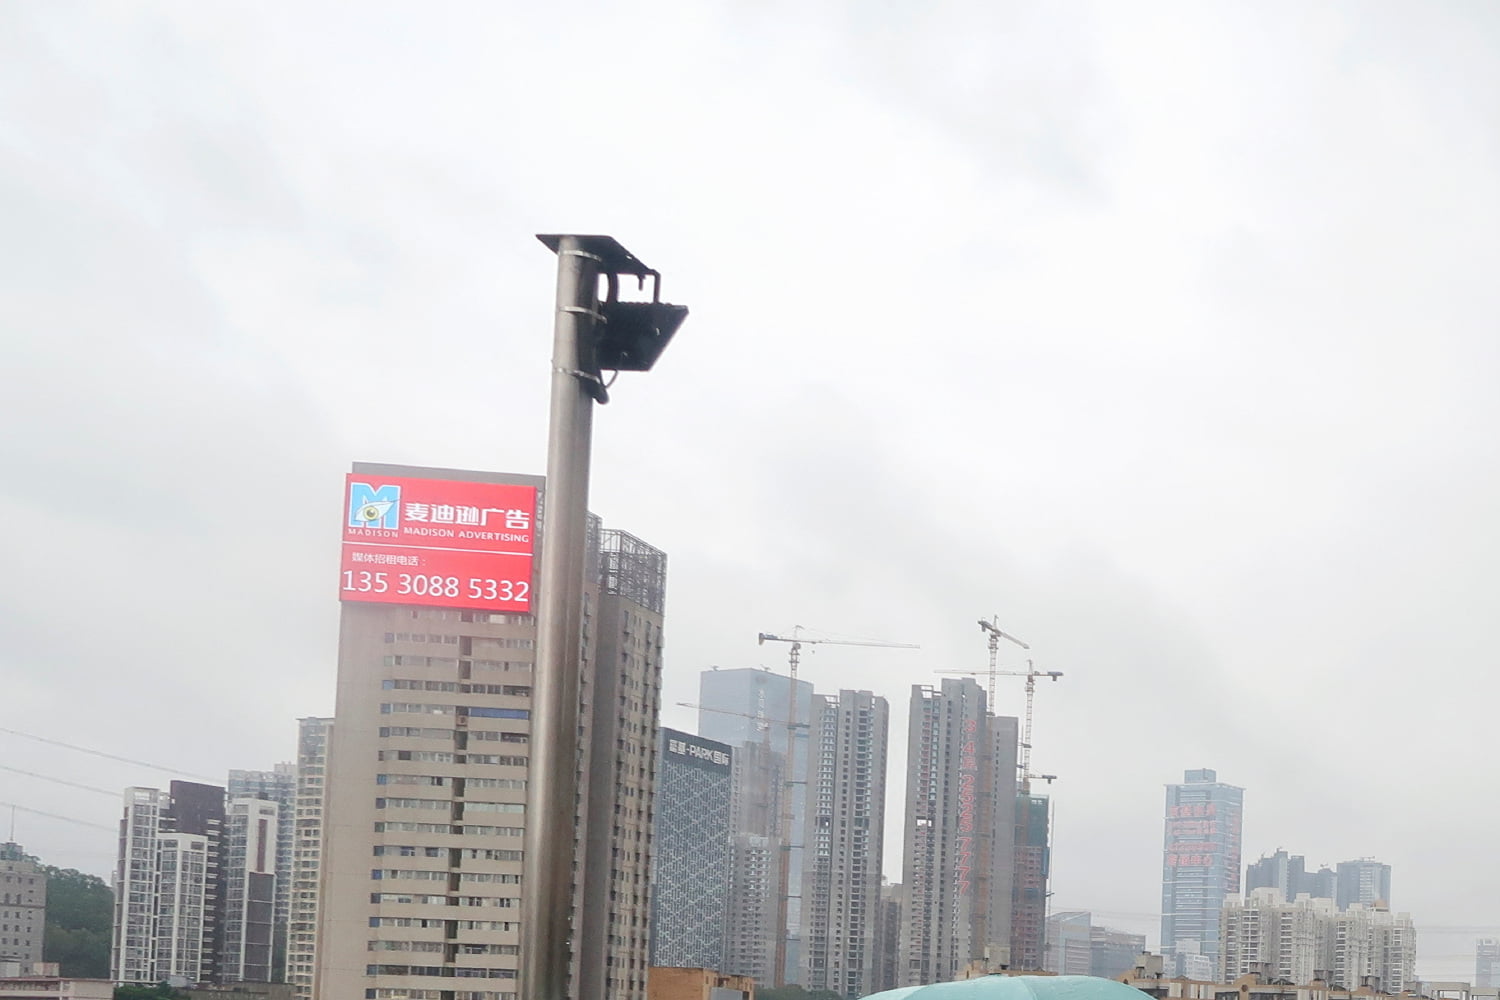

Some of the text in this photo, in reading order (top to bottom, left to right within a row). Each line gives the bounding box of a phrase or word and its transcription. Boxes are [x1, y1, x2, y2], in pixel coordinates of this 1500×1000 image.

[404, 502, 530, 530] 麦迪逊广告
[347, 528, 399, 538] MADISON
[403, 526, 529, 543] MADISON ADVERTISING
[343, 570, 529, 602] 135 3088 5332
